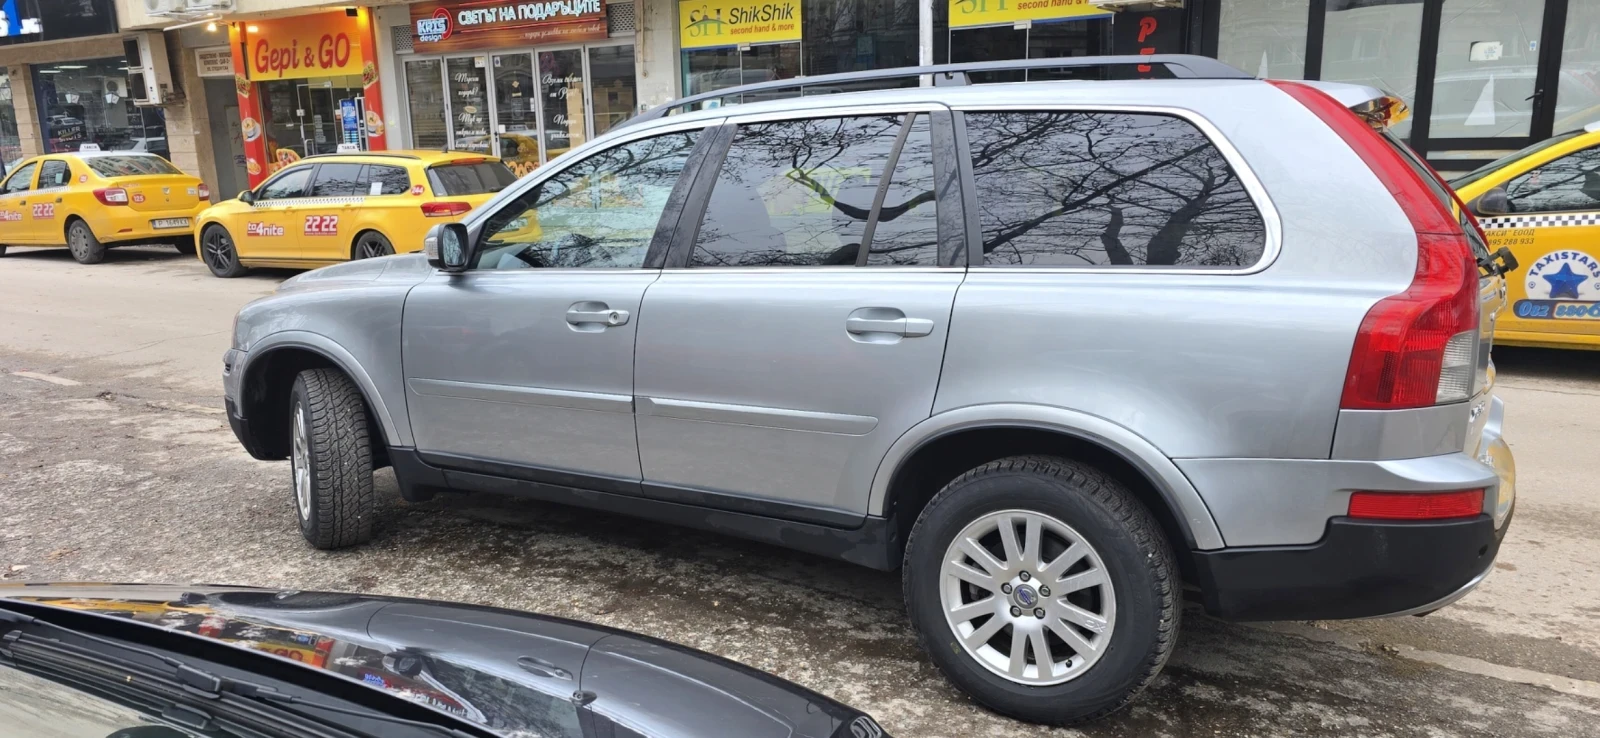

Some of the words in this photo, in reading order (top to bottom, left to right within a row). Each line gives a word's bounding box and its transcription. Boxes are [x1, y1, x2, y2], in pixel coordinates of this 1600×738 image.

[458, 8, 497, 25] СВЕТЪТ
[499, 7, 517, 21] НА
[518, 0, 600, 20] ПОДАРЪЦИТЕ
[729, 3, 794, 24] ShikShik
[417, 19, 447, 34] KRIS
[730, 25, 752, 35] second
[754, 23, 770, 33] hand
[777, 23, 795, 31] more
[420, 34, 443, 42] design
[255, 39, 299, 78] Gepi
[304, 47, 315, 68] &
[318, 32, 351, 69] GO
[248, 221, 284, 236] to4nite
[305, 216, 320, 231] 22
[321, 215, 338, 231] 22
[1513, 228, 1535, 237] ЕООД
[1520, 237, 1534, 245] 933
[1529, 251, 1600, 278] TAXISTARS
[1518, 301, 1550, 317] 082
